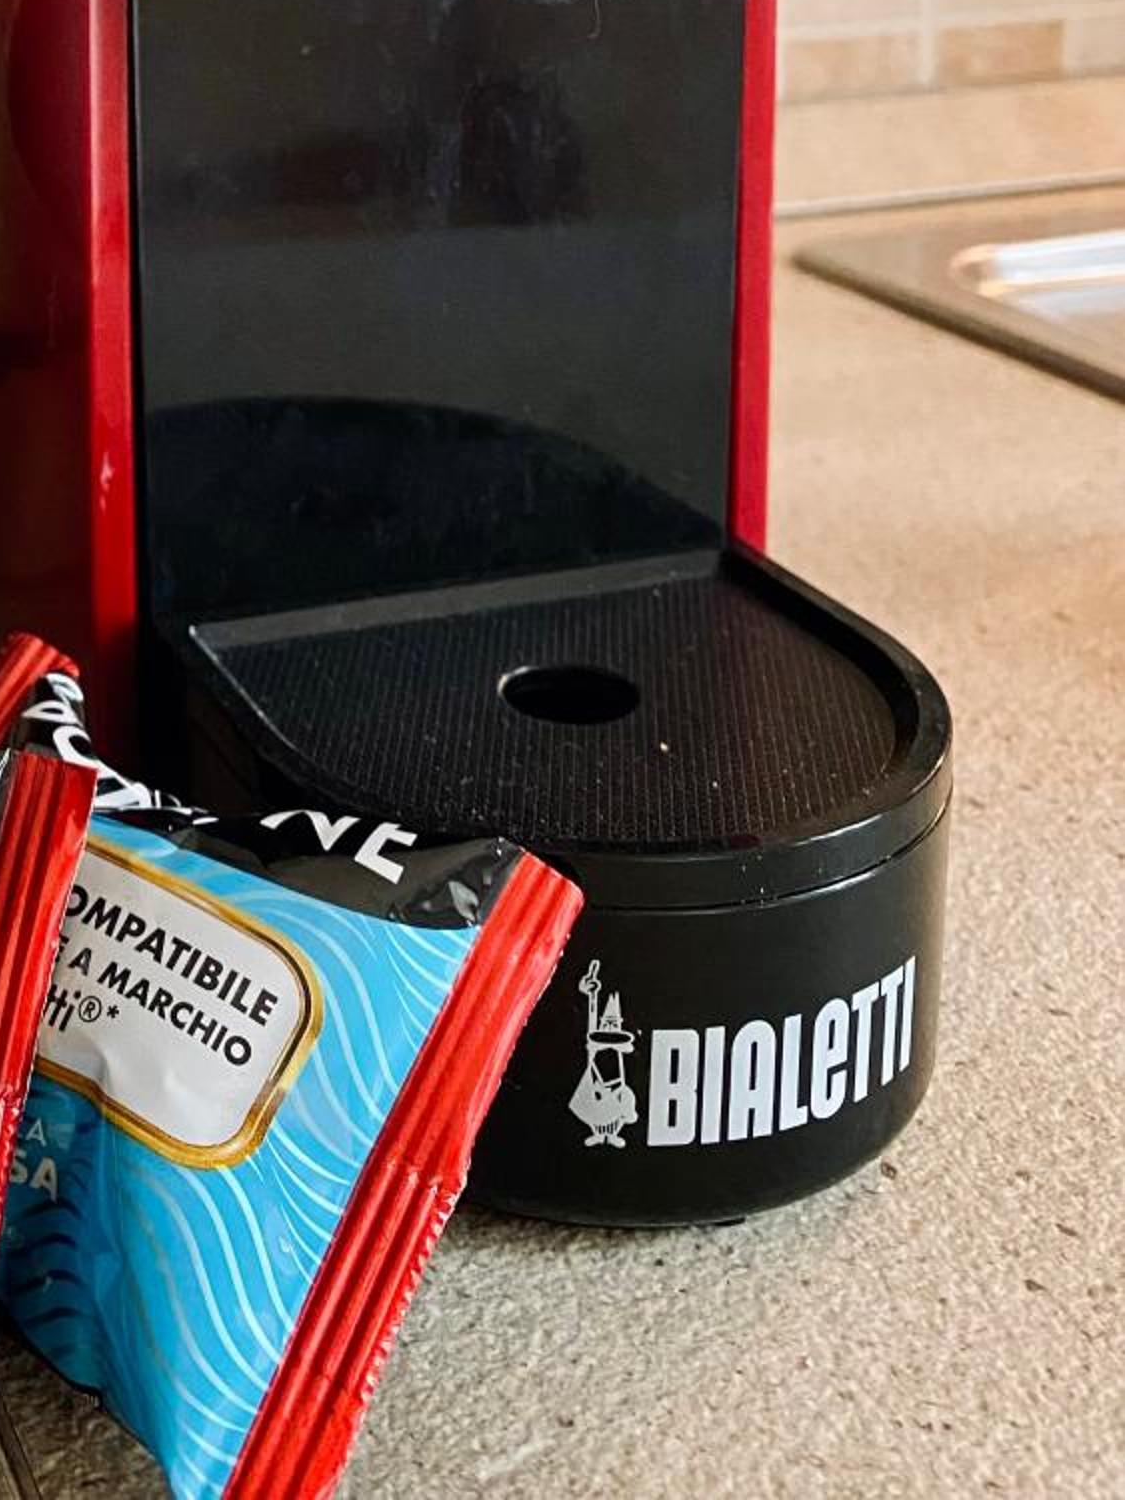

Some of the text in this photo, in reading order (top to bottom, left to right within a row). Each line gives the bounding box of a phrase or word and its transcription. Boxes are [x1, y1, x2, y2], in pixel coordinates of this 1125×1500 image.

[64, 884, 280, 1027] OMPATIBILE
[68, 947, 93, 977] A
[96, 961, 253, 1068] MARCHIO
